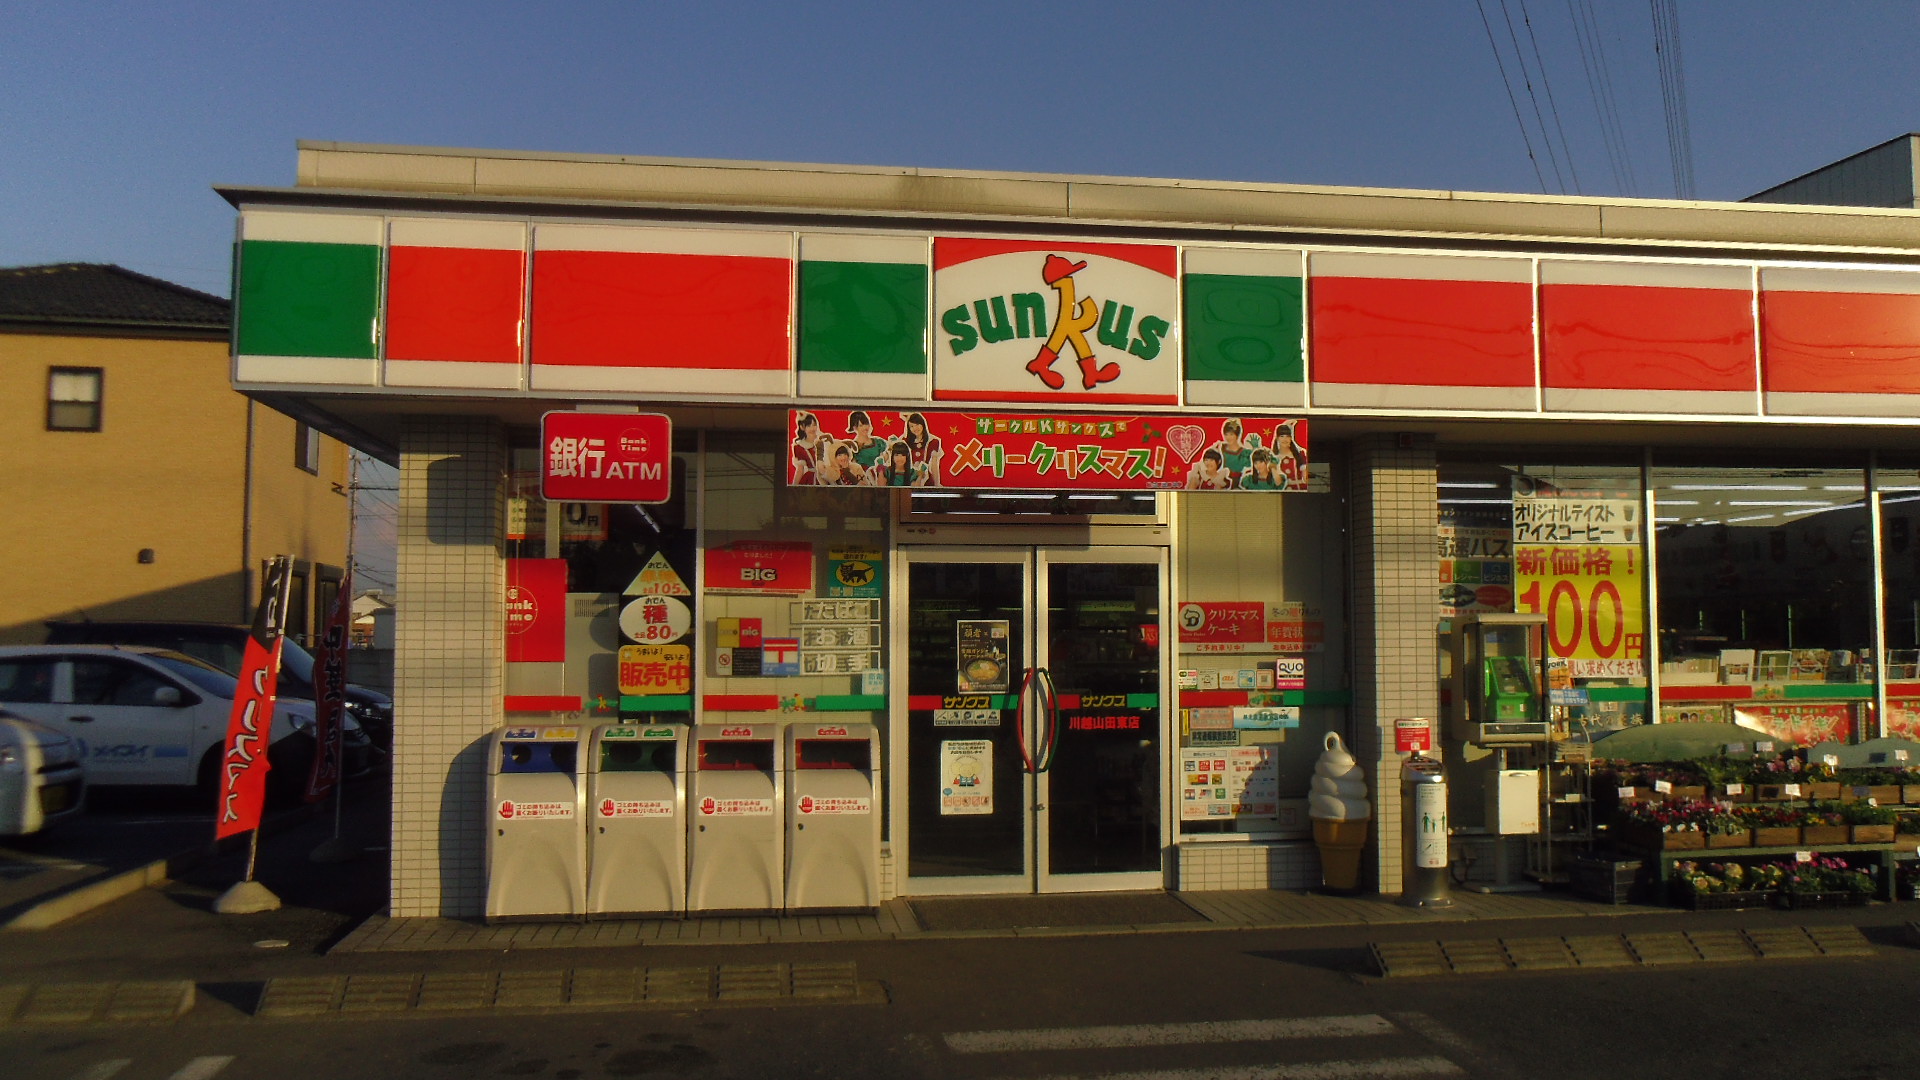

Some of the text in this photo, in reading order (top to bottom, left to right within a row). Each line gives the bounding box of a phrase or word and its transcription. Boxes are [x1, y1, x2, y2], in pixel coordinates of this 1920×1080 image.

[550, 436, 662, 481] 銀行 ATM
[1515, 503, 1615, 523] オリジナルテイスト
[1515, 523, 1615, 541] アイスコーヒー
[645, 597, 667, 605] おでん
[643, 605, 668, 625] 種
[815, 602, 870, 618] たばこ
[1207, 609, 1260, 621] クリスマス
[815, 628, 869, 645] お酒
[1207, 623, 1240, 635] ケーキ
[815, 653, 869, 672] 切手
[1278, 662, 1304, 672] QUO
[620, 661, 690, 688] 販売中
[944, 695, 990, 709] サンクス
[1081, 695, 1126, 708] サンクス
[1069, 716, 1141, 730] 川越山田東店
